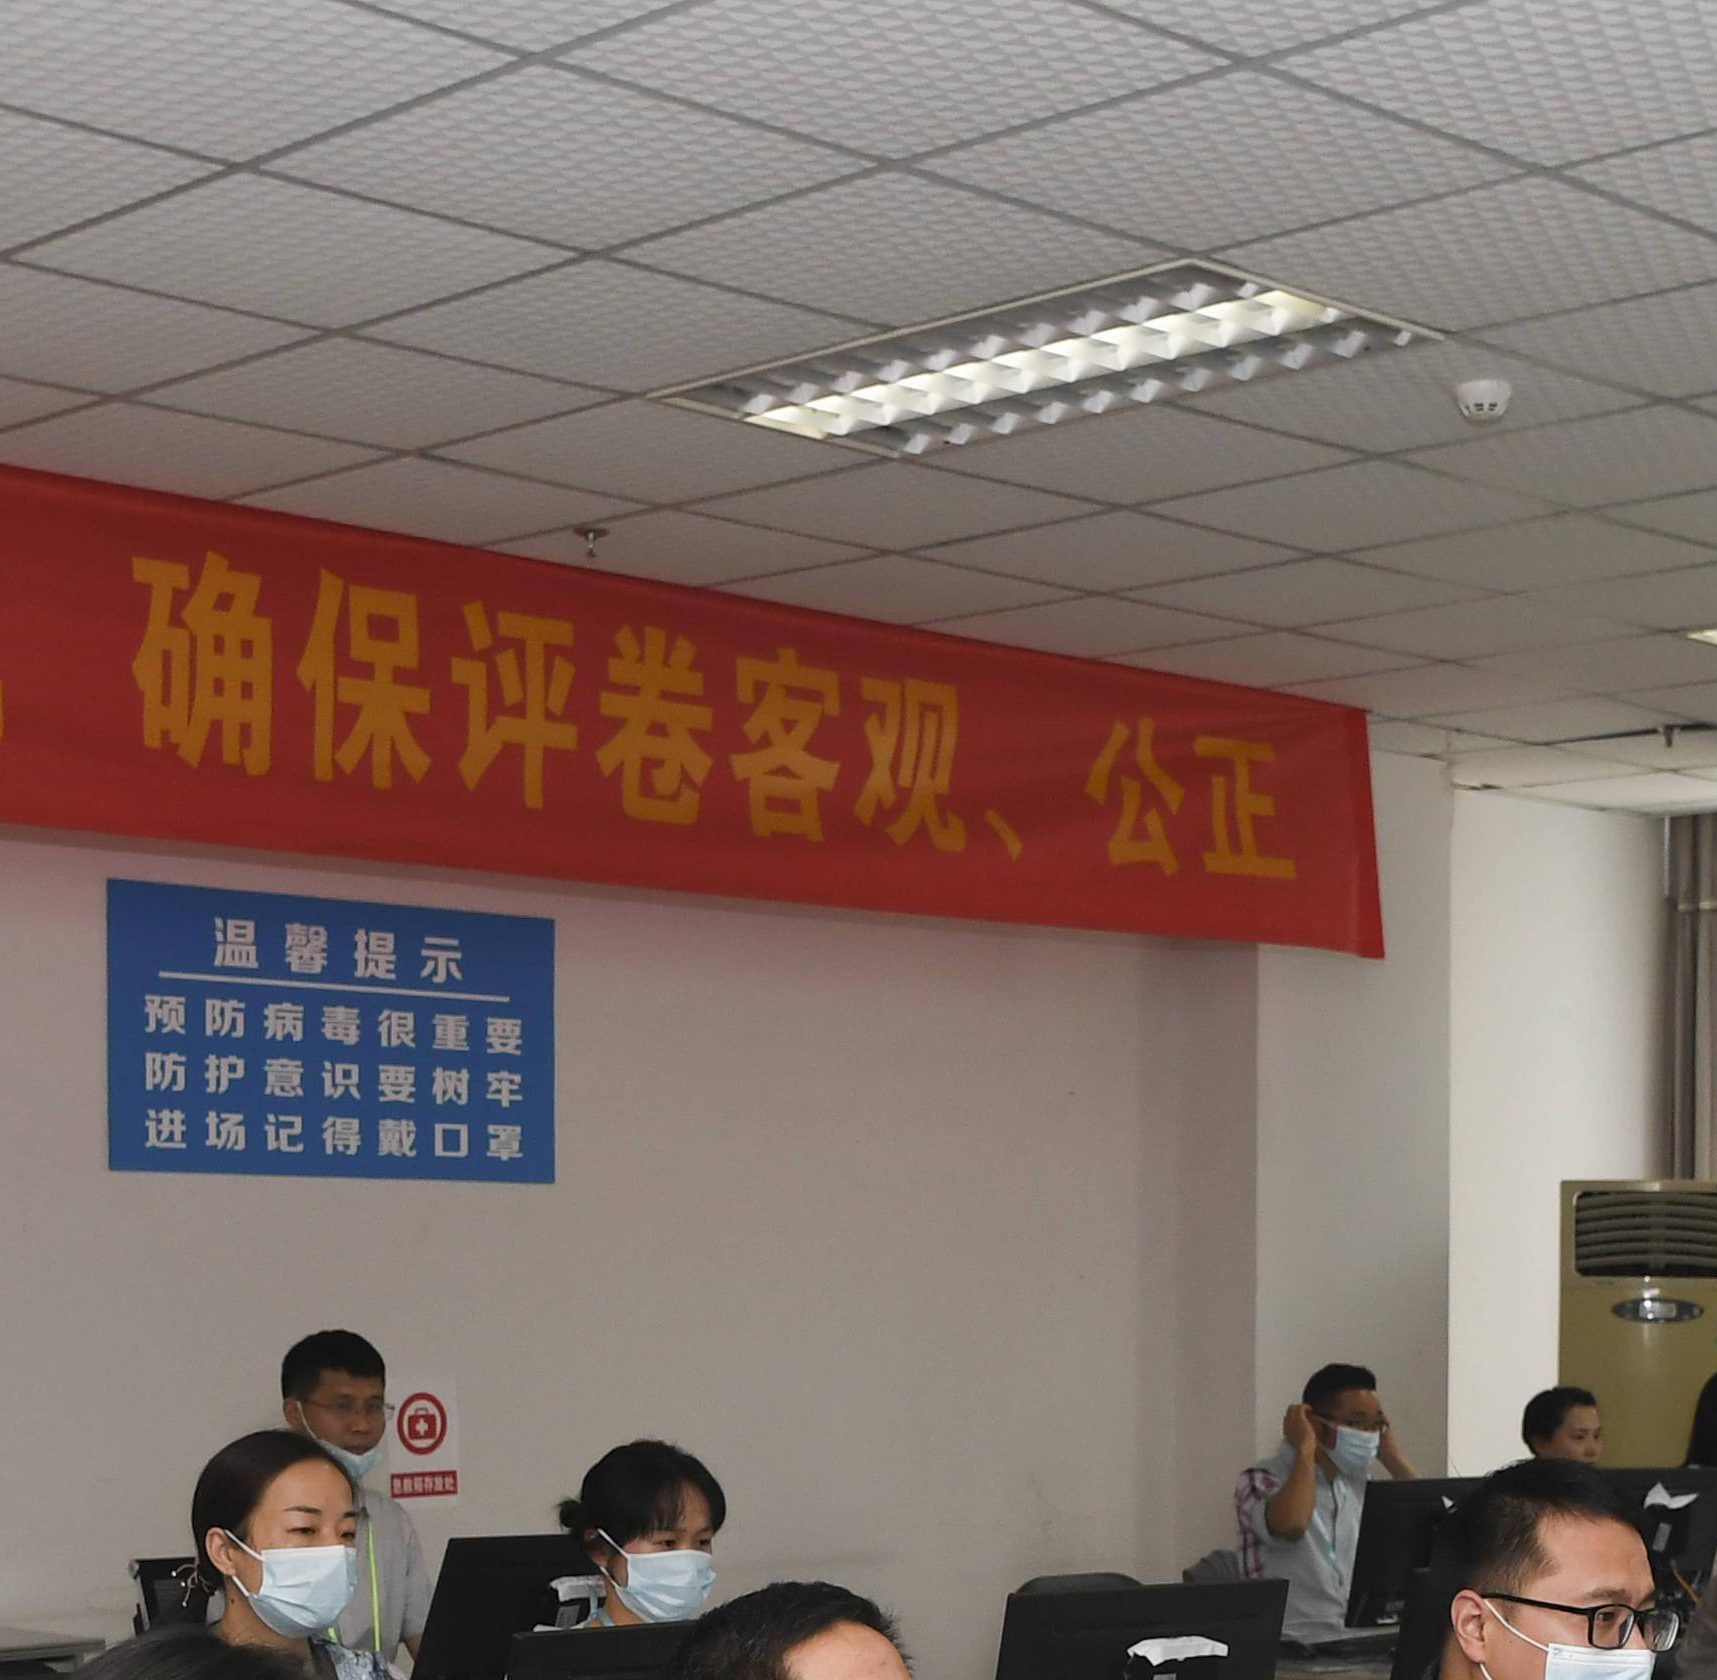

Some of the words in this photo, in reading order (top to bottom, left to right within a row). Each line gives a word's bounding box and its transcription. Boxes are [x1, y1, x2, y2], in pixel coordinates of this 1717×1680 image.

[213, 916, 463, 984] 温馨提示
[144, 994, 522, 1056] 预防病毒很重要
[144, 1051, 523, 1108] 防护意识要树牢
[144, 1108, 523, 1162] 进场记得戴口罩
